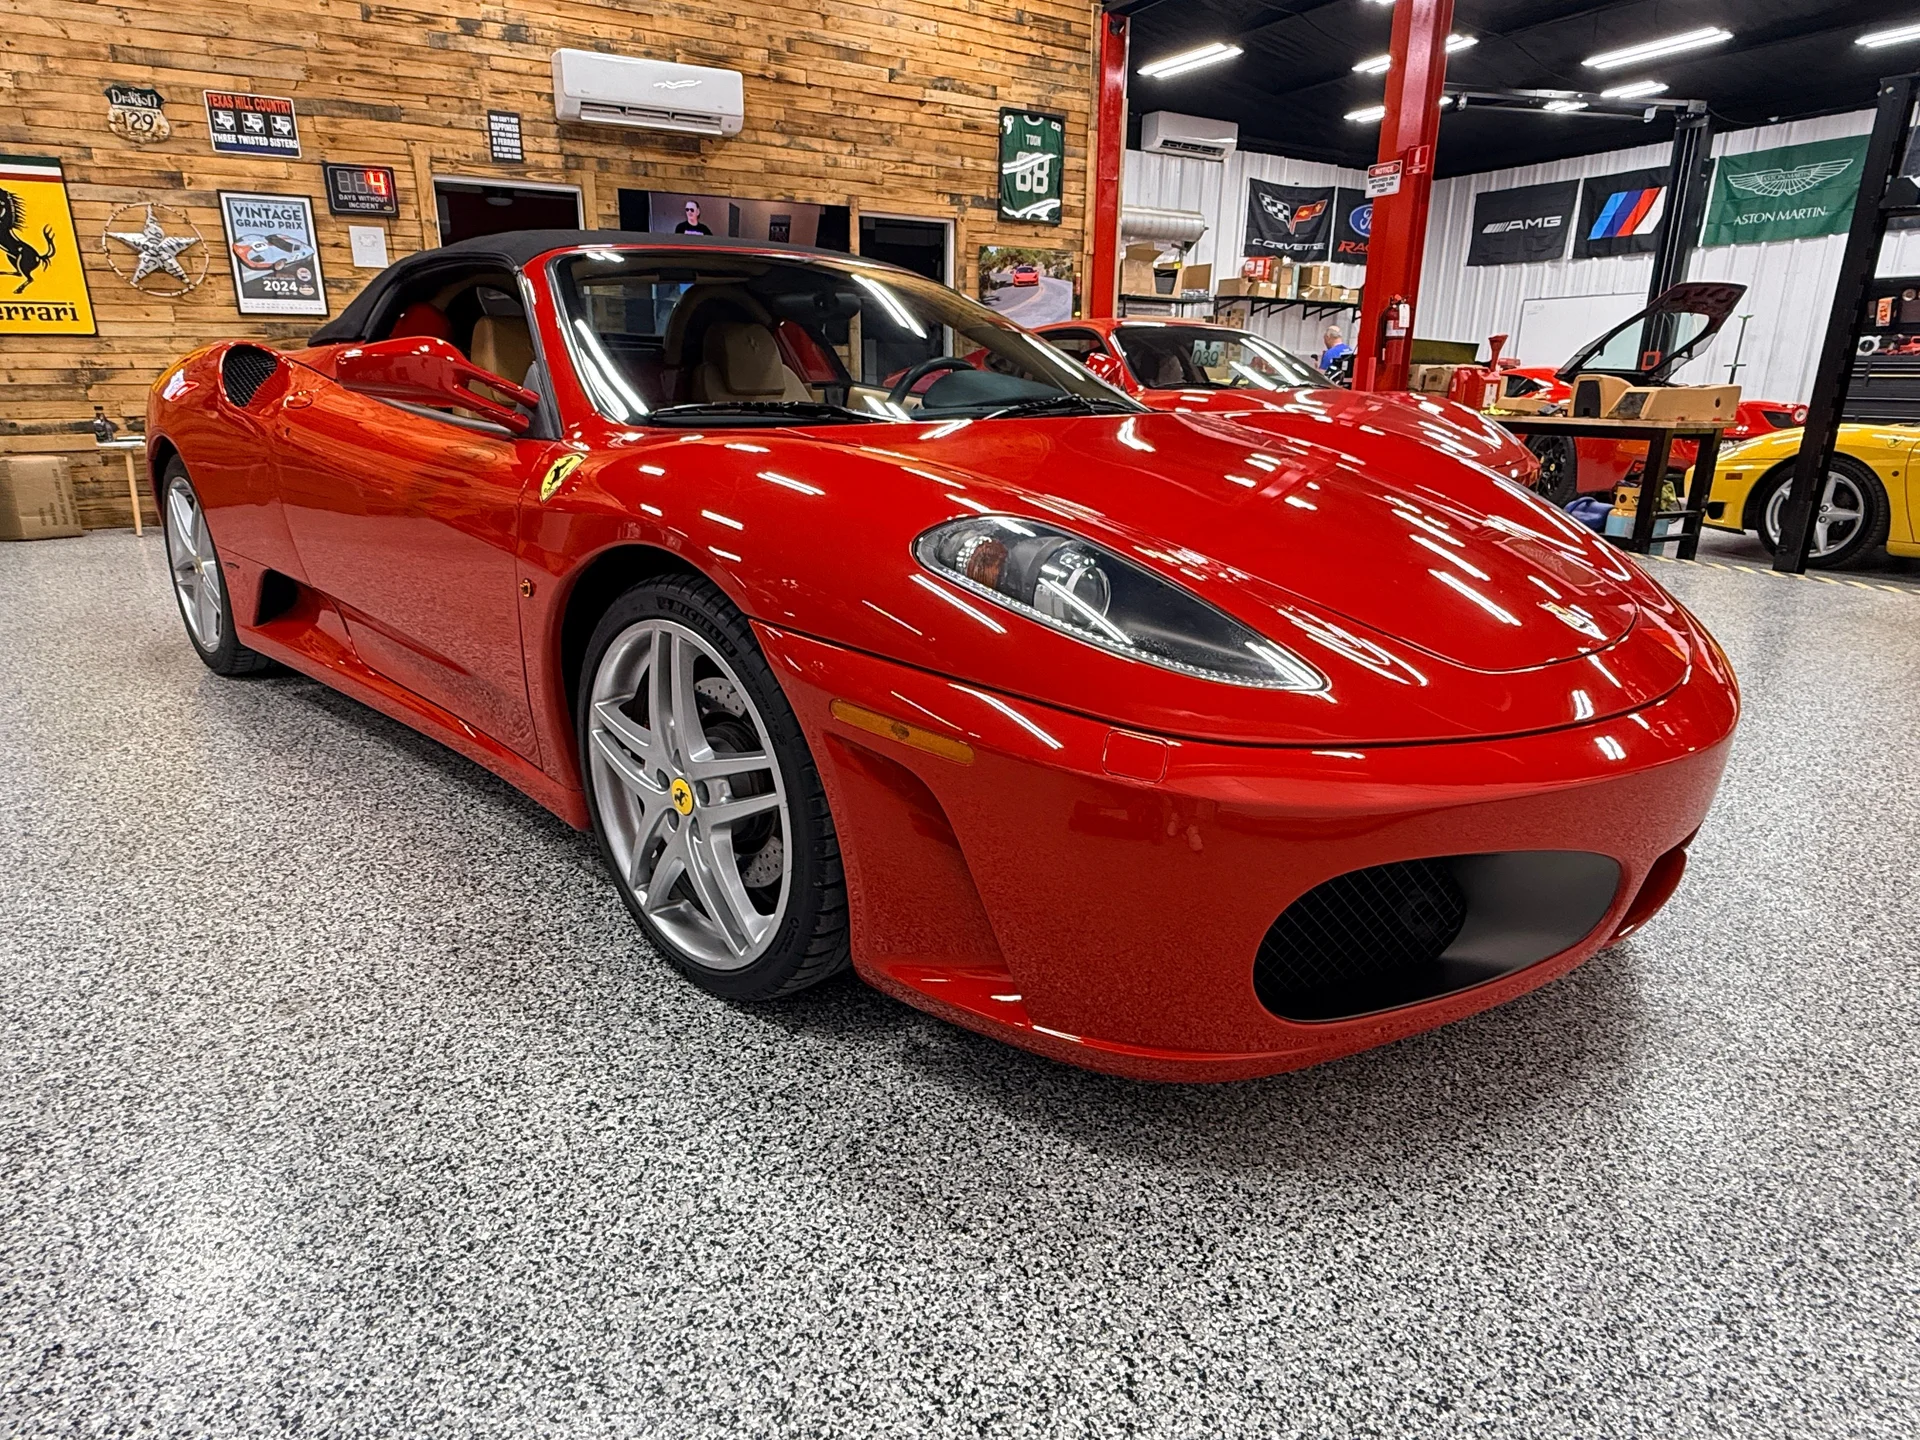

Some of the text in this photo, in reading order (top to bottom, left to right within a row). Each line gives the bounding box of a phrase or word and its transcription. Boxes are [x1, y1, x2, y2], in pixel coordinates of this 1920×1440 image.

[207, 93, 291, 114] TEXAS HILL COUNTRY
[121, 111, 154, 132] 129
[212, 132, 299, 149] THREE TWISTED SISTERS
[1016, 151, 1050, 194] 88
[1375, 165, 1394, 174] NOTICE
[368, 171, 387, 195] 4
[348, 202, 379, 210] INCIDENT
[358, 195, 388, 203] WITHOUT
[233, 206, 302, 221] VINTAGE
[1734, 206, 1826, 226] ASTON MARTIN
[236, 218, 303, 230] GRAND PRIX
[1505, 215, 1562, 232] AMG
[1252, 238, 1325, 251] CORVETTE
[263, 280, 298, 292] 2024
[0, 302, 79, 321] rrari
[1192, 349, 1219, 367] 039
[672, 602, 735, 654] MICHELIN
